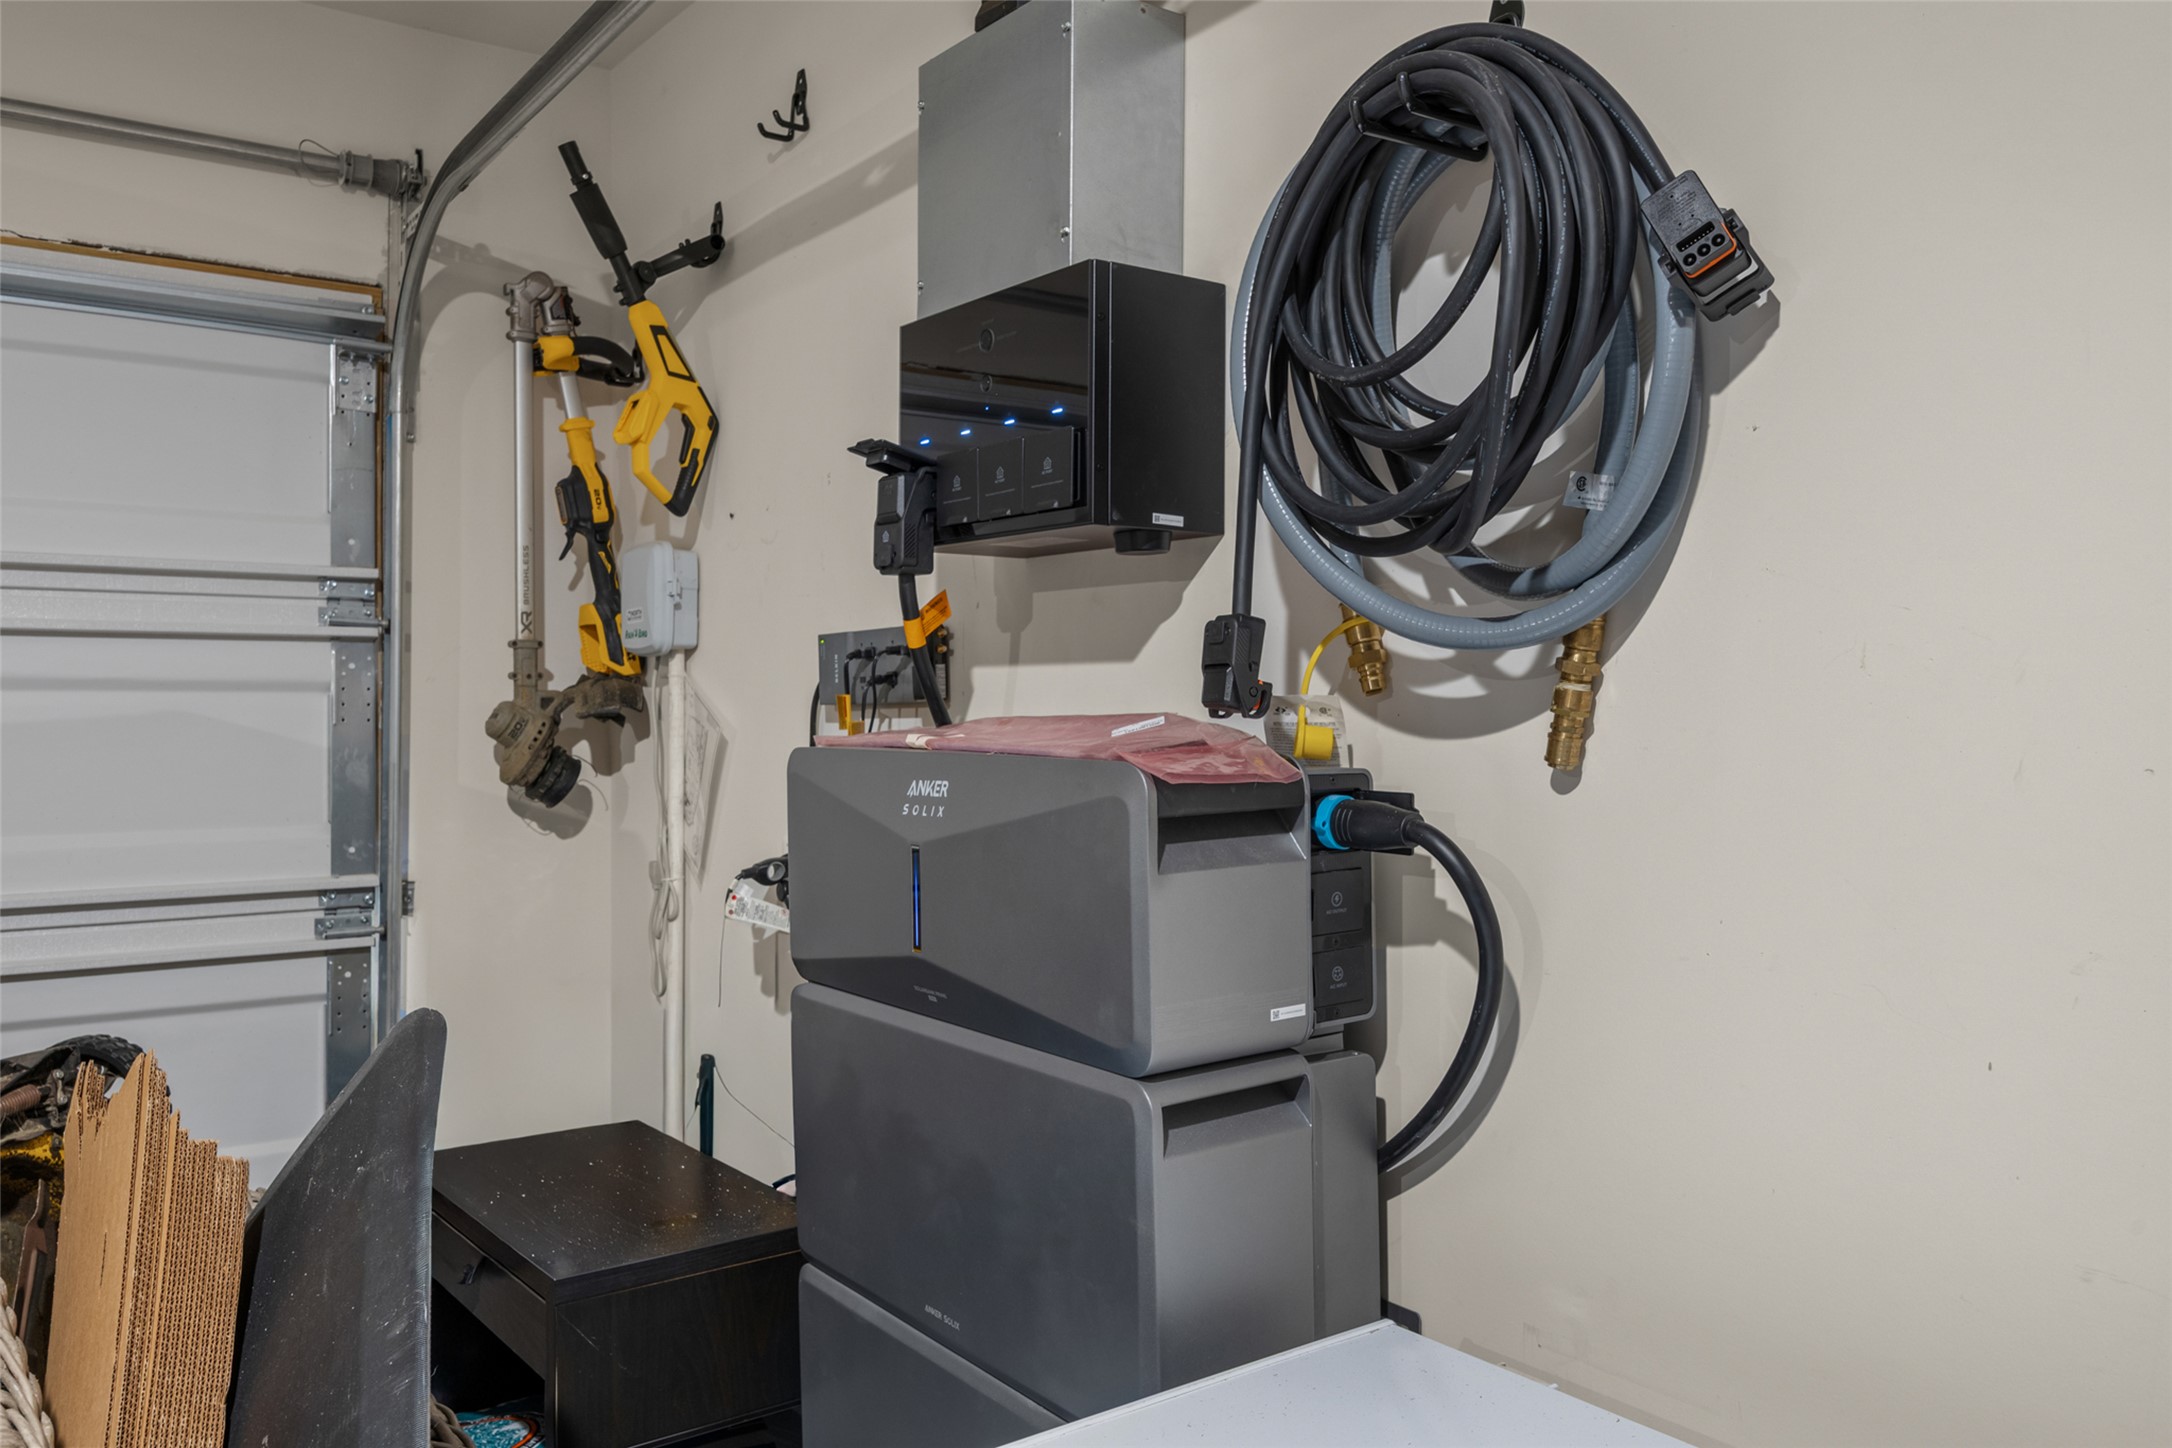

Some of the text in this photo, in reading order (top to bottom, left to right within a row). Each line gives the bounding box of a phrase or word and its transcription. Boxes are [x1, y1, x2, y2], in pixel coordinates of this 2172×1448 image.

[520, 544, 533, 635] XR BRUSHLESS
[906, 779, 949, 798] ANKER
[902, 803, 945, 818] SOLIX
